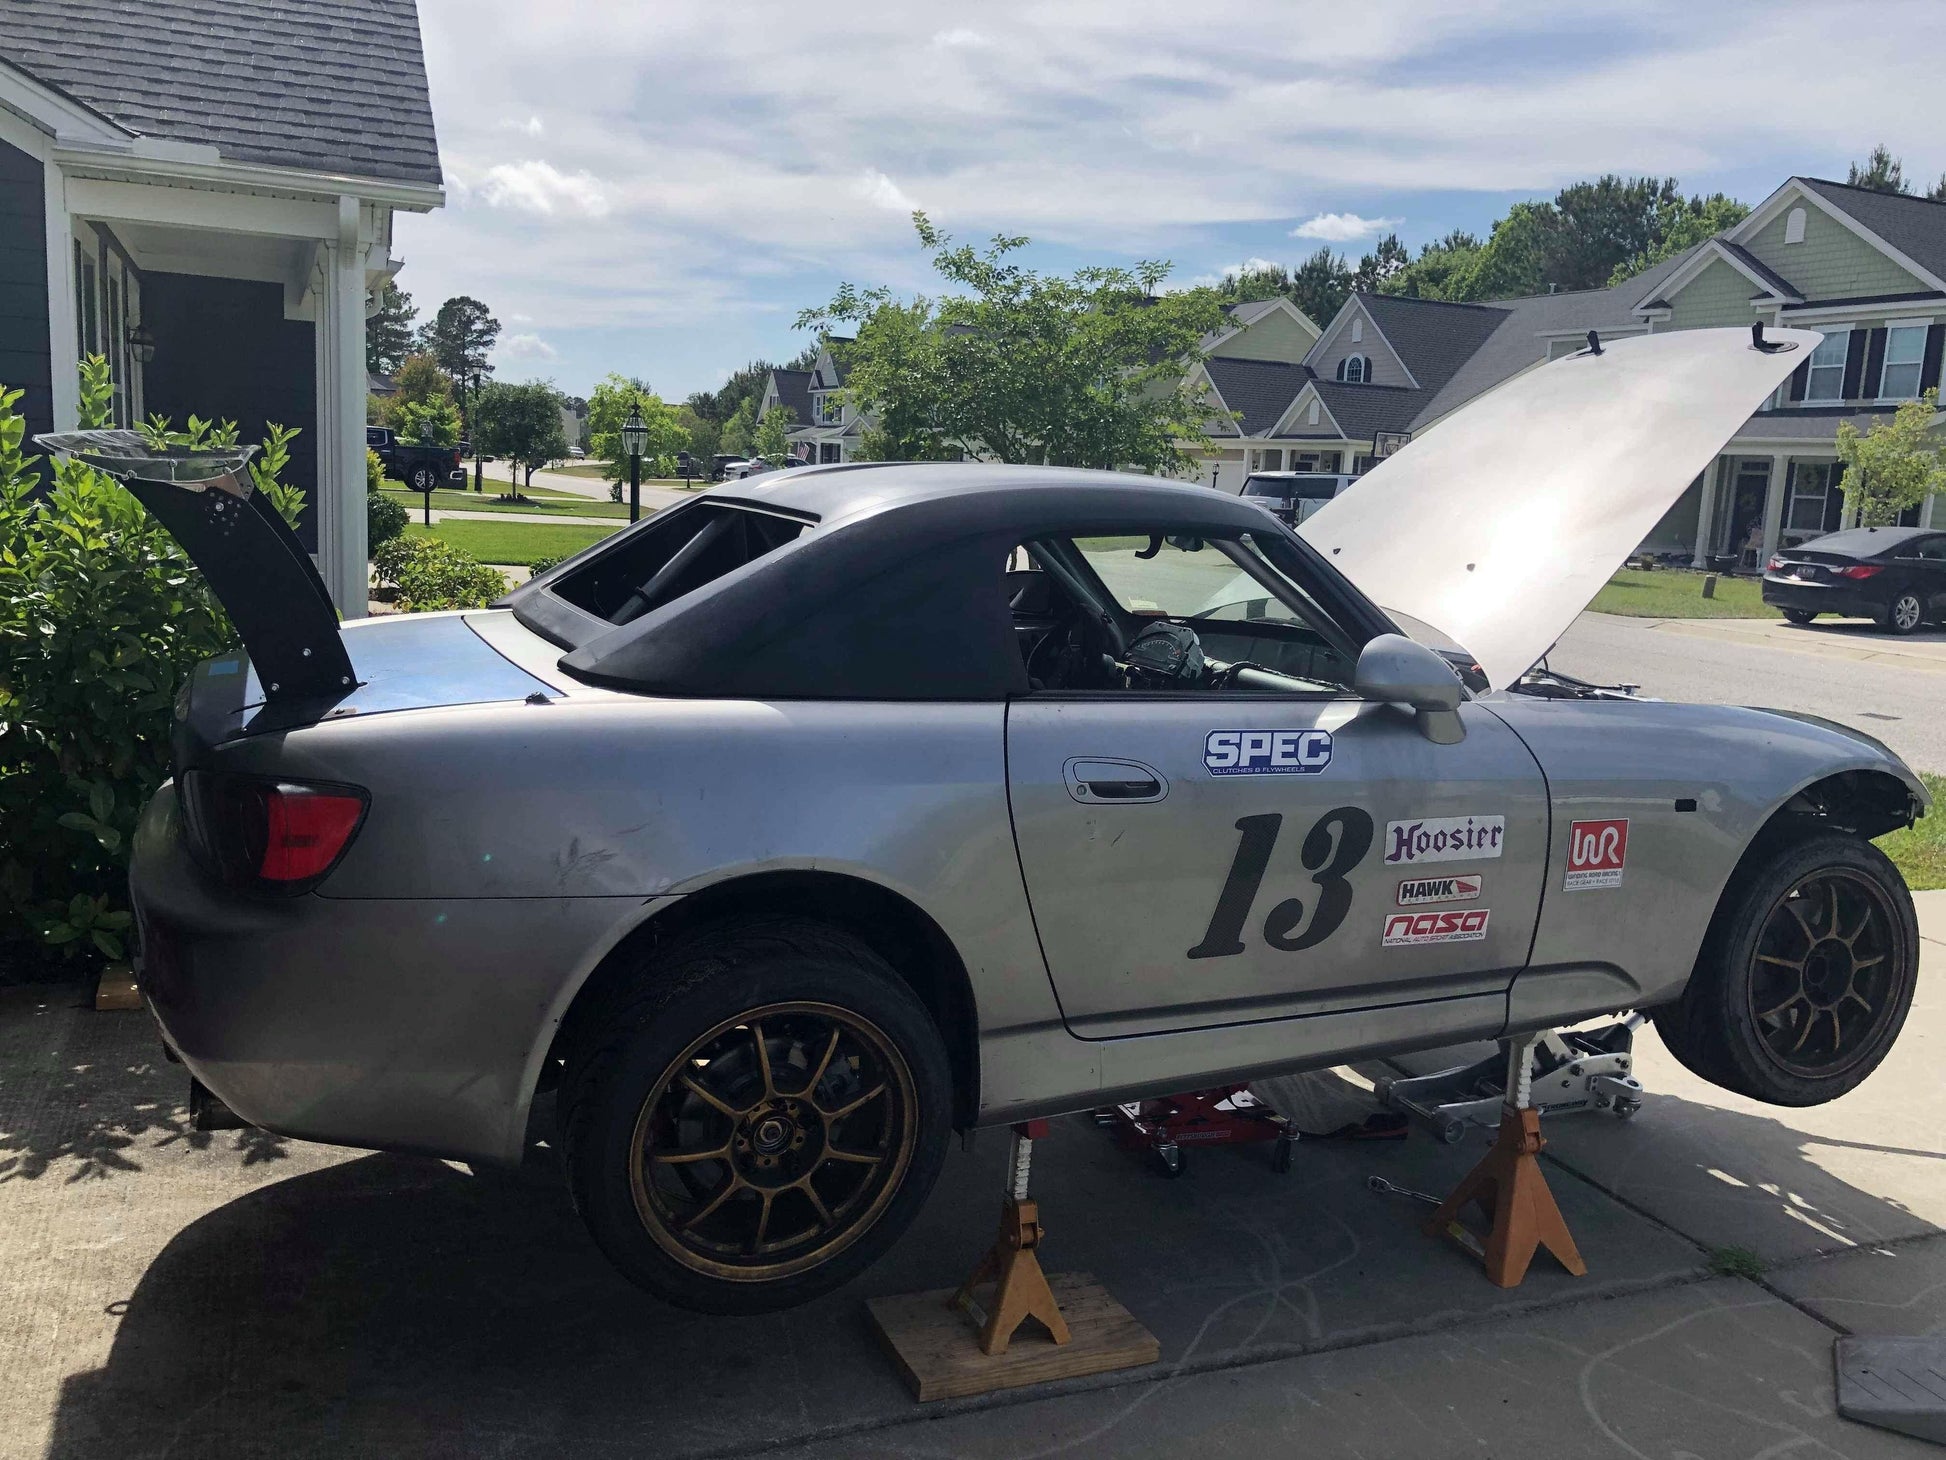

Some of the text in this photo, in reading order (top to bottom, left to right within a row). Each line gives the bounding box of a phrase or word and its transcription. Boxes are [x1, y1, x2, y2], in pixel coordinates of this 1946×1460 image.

[1206, 732, 1330, 767] SPEC
[1385, 817, 1503, 862] Hoosier
[1187, 806, 1374, 960] 13
[1402, 879, 1454, 899] HAWK
